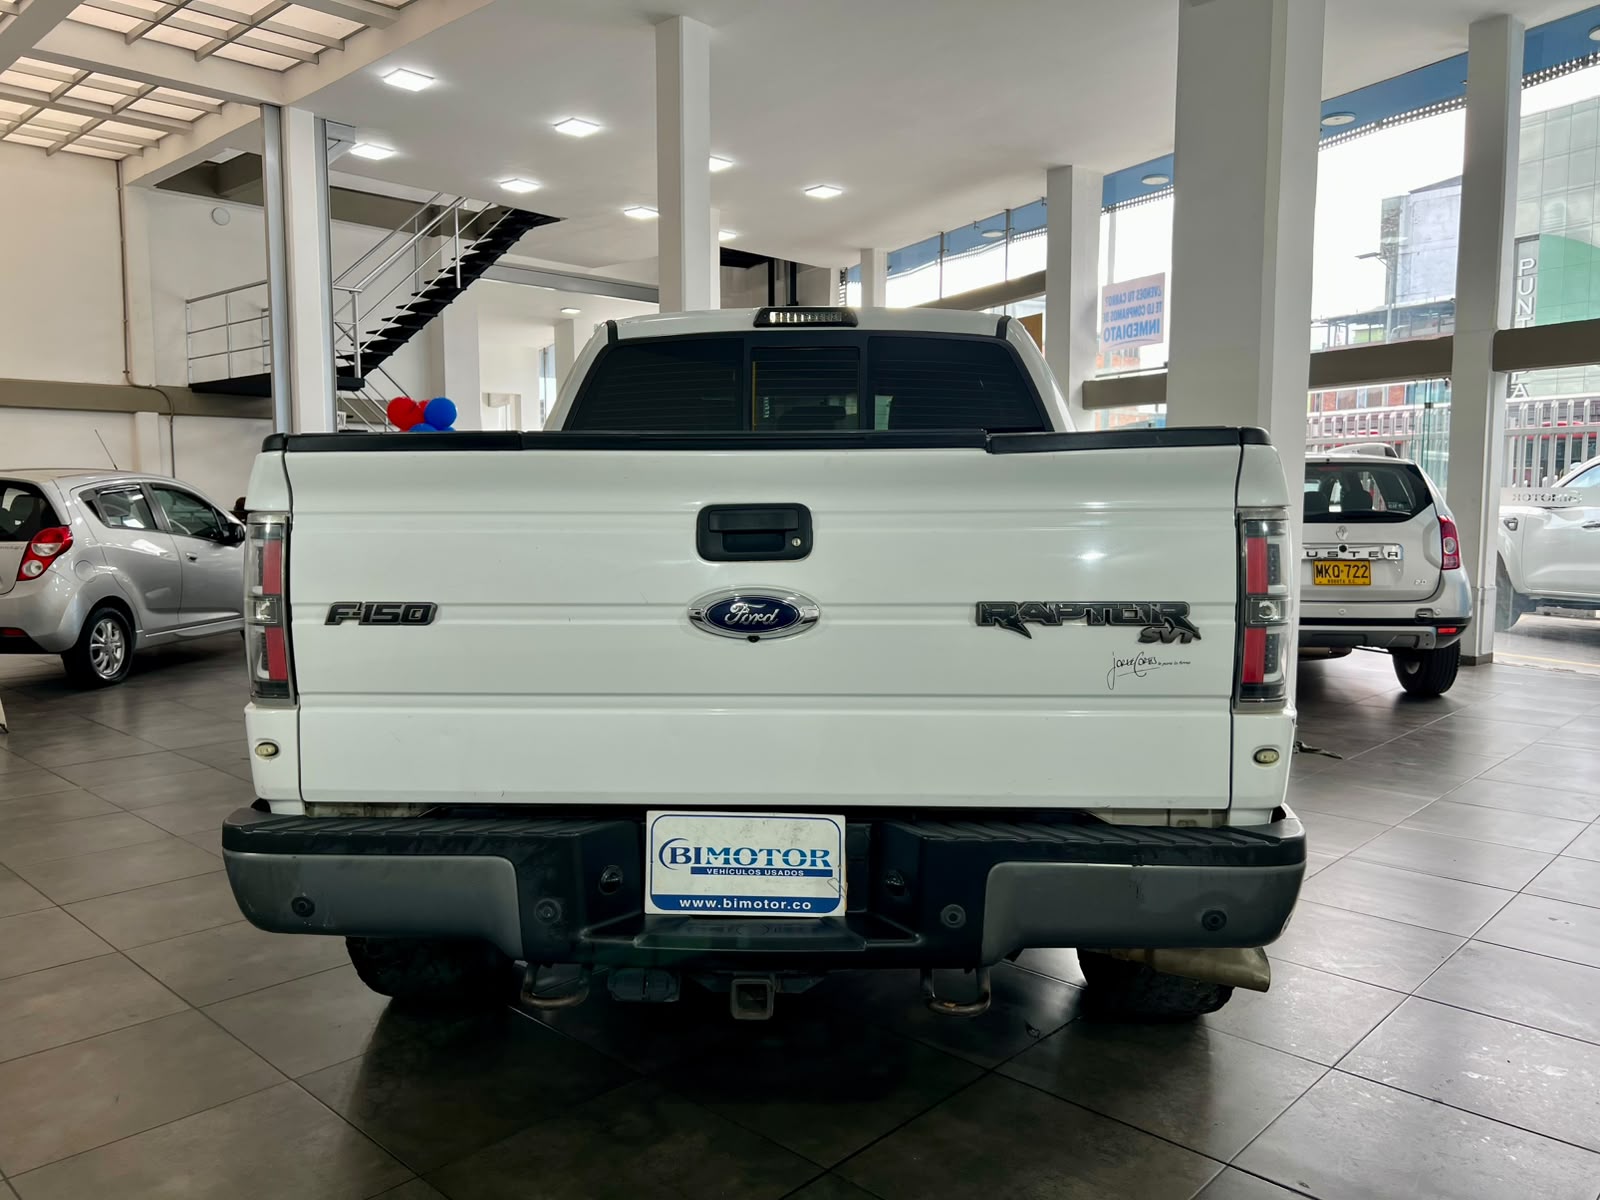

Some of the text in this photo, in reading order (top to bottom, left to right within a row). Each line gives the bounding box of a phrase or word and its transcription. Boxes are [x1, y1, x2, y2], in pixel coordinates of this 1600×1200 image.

[1516, 257, 1535, 329] PUNT
[1306, 550, 1398, 558] USTER
[324, 601, 438, 626] F-150
[724, 602, 781, 625] Ford
[976, 601, 1201, 640] RAPTOR
[1138, 626, 1194, 644] SVT
[669, 846, 832, 868] BIMOTOR
[706, 866, 805, 877] VEHÍCULOS USADOS
[679, 898, 812, 910] www.bimotor.co
